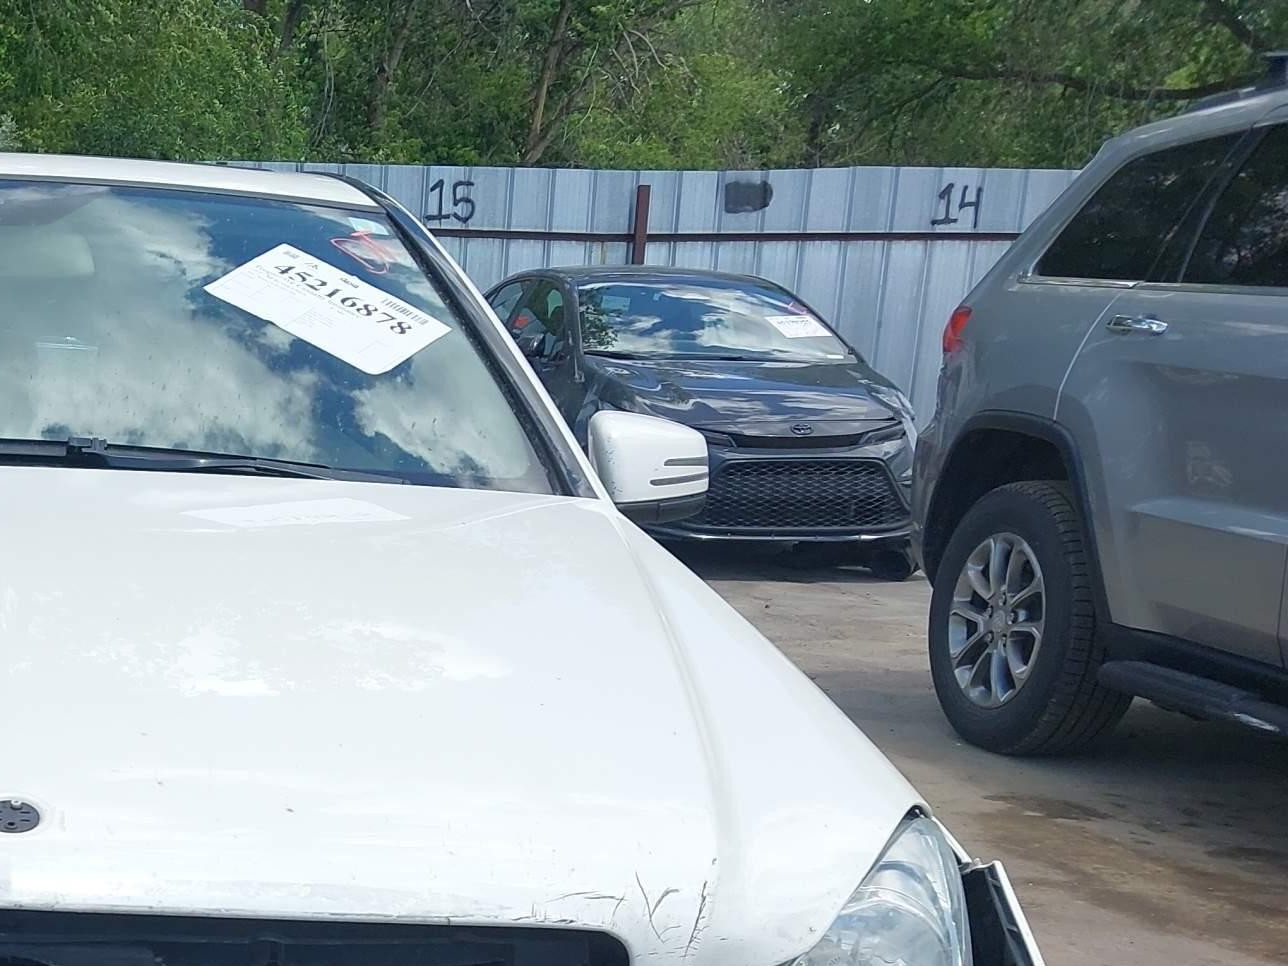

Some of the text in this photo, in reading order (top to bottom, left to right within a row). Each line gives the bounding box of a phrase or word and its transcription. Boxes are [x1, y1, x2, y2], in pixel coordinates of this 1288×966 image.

[424, 179, 475, 224] 15
[931, 182, 983, 229] 14
[273, 264, 412, 335] 45216878
